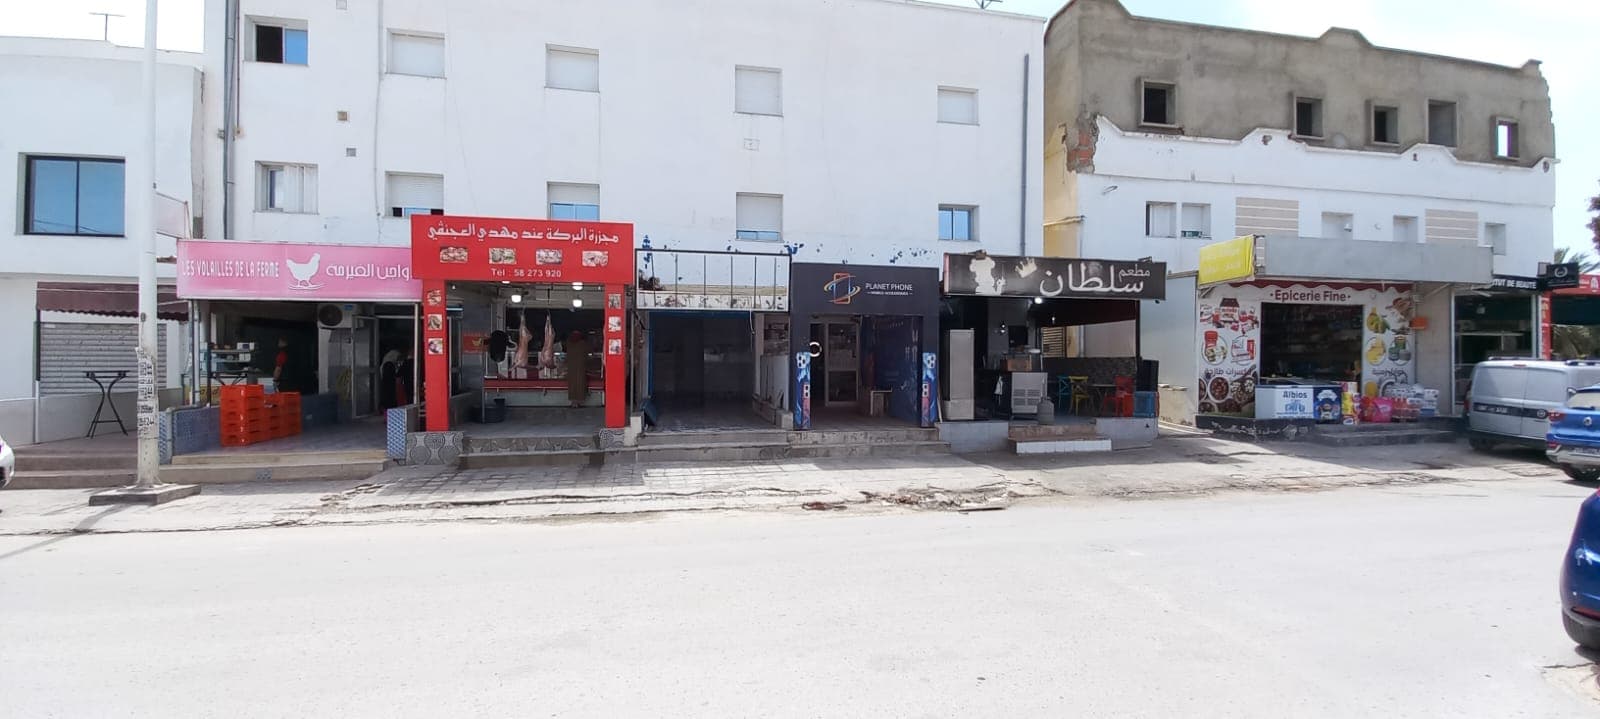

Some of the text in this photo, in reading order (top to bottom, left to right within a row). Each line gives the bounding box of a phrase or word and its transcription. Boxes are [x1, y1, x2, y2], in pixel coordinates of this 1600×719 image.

[477, 226, 518, 241] مهدي
[521, 228, 544, 239] عند
[546, 228, 587, 244] البركة
[588, 229, 619, 245] مجزرة
[182, 260, 279, 278] LES VOLAILLES DE LA FERME
[514, 269, 525, 277] 58
[527, 269, 543, 277] 273
[545, 269, 562, 278] 920
[1119, 263, 1150, 282] مطعم
[865, 282, 913, 291] PLANET PHONE
[1039, 262, 1144, 296] سلطان
[1275, 290, 1346, 302] Epicerie Fine
